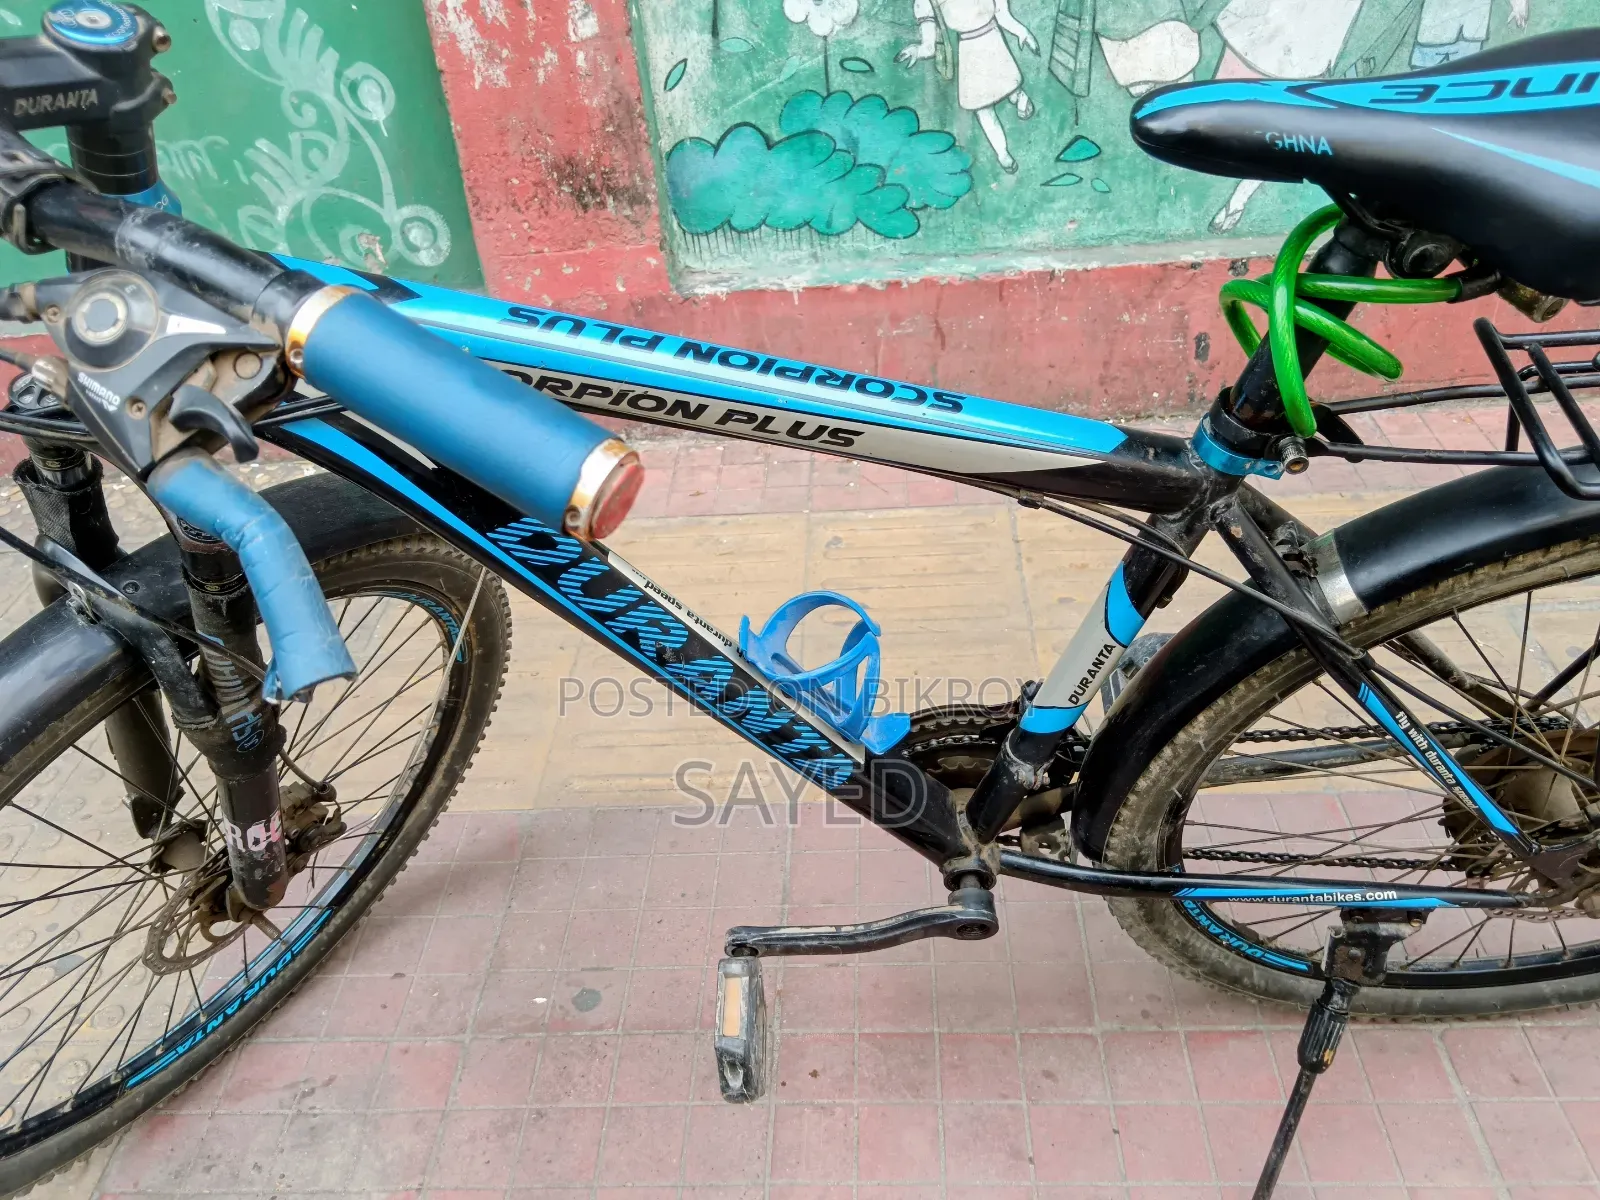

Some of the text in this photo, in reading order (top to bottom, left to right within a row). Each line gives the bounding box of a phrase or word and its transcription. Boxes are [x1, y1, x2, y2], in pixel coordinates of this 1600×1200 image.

[13, 88, 98, 116] DURANTA
[1253, 131, 1333, 156] GHNA
[498, 306, 967, 415] SCORPION PLUS
[77, 371, 121, 406] SHIMANO
[714, 408, 865, 448] PLUS
[686, 609, 733, 648] duranta
[486, 517, 855, 790] DURANTA
[1068, 643, 1117, 706] DURANTA
[1395, 711, 1411, 730] fly
[1408, 728, 1428, 750] with
[1425, 750, 1456, 784] duranta
[1228, 890, 1397, 903] www.durantabikes.com
[1182, 899, 1264, 958] DURANTA
[175, 949, 293, 1056] DURANTA
